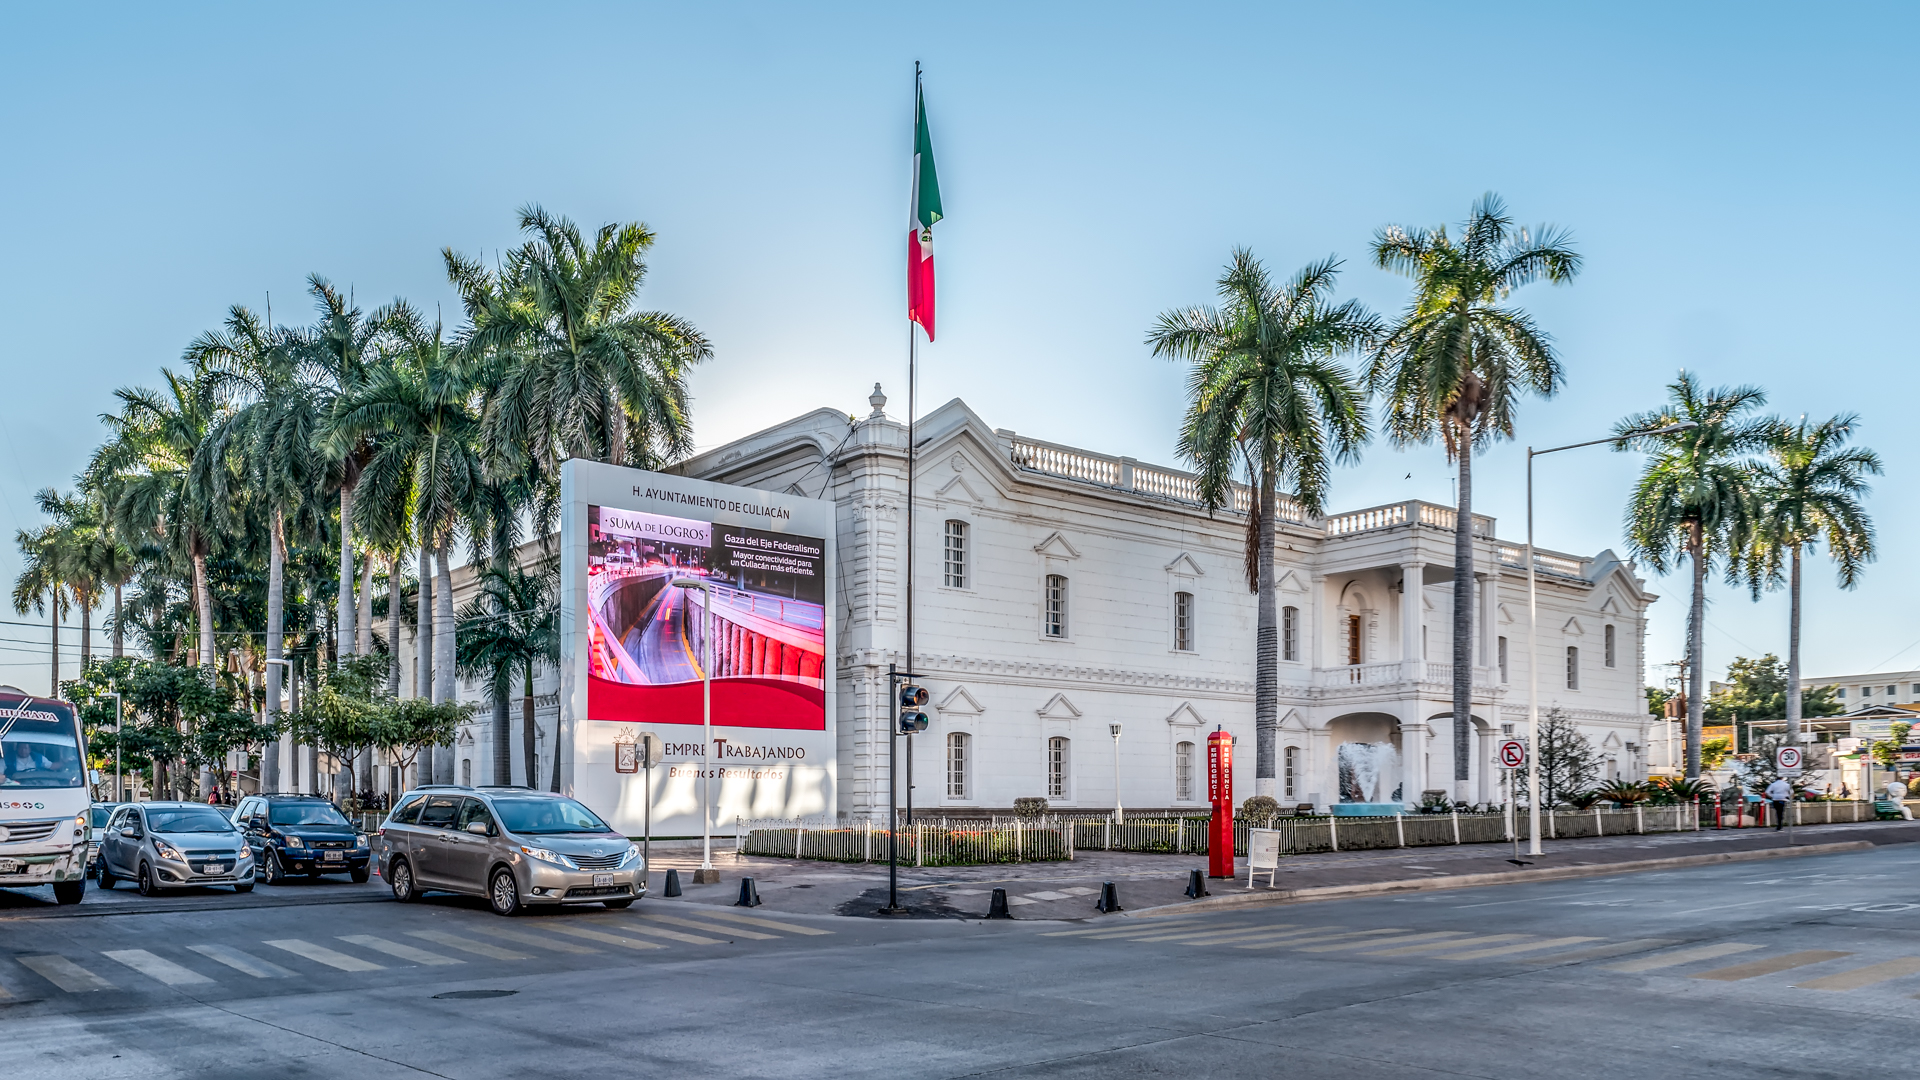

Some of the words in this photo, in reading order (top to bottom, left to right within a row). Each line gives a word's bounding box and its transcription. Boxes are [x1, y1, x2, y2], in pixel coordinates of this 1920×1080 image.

[632, 485, 643, 497] H.
[645, 488, 726, 511] AYUNTAMIENTO
[728, 501, 741, 513] DE
[743, 503, 790, 520] CULIACÁN
[609, 516, 643, 532] SUMA
[644, 523, 656, 533] DE
[659, 524, 704, 540] LOGROS
[724, 533, 745, 545] Gaza
[746, 536, 759, 547] del
[760, 538, 772, 549] Eje
[773, 540, 820, 555] Federalismo
[730, 559, 740, 567] un
[740, 559, 770, 571] Culiacán
[770, 564, 785, 573] más
[785, 565, 815, 576] eficiente.
[733, 550, 755, 562] Mayor
[755, 553, 797, 567] conectividad
[797, 559, 812, 568] para
[665, 743, 706, 757] EMPRE
[712, 738, 806, 760] TRABAJANDO
[1783, 751, 1796, 761] 30
[717, 767, 784, 780] Resultados
[1210, 747, 1218, 800] EMERGENCIA
